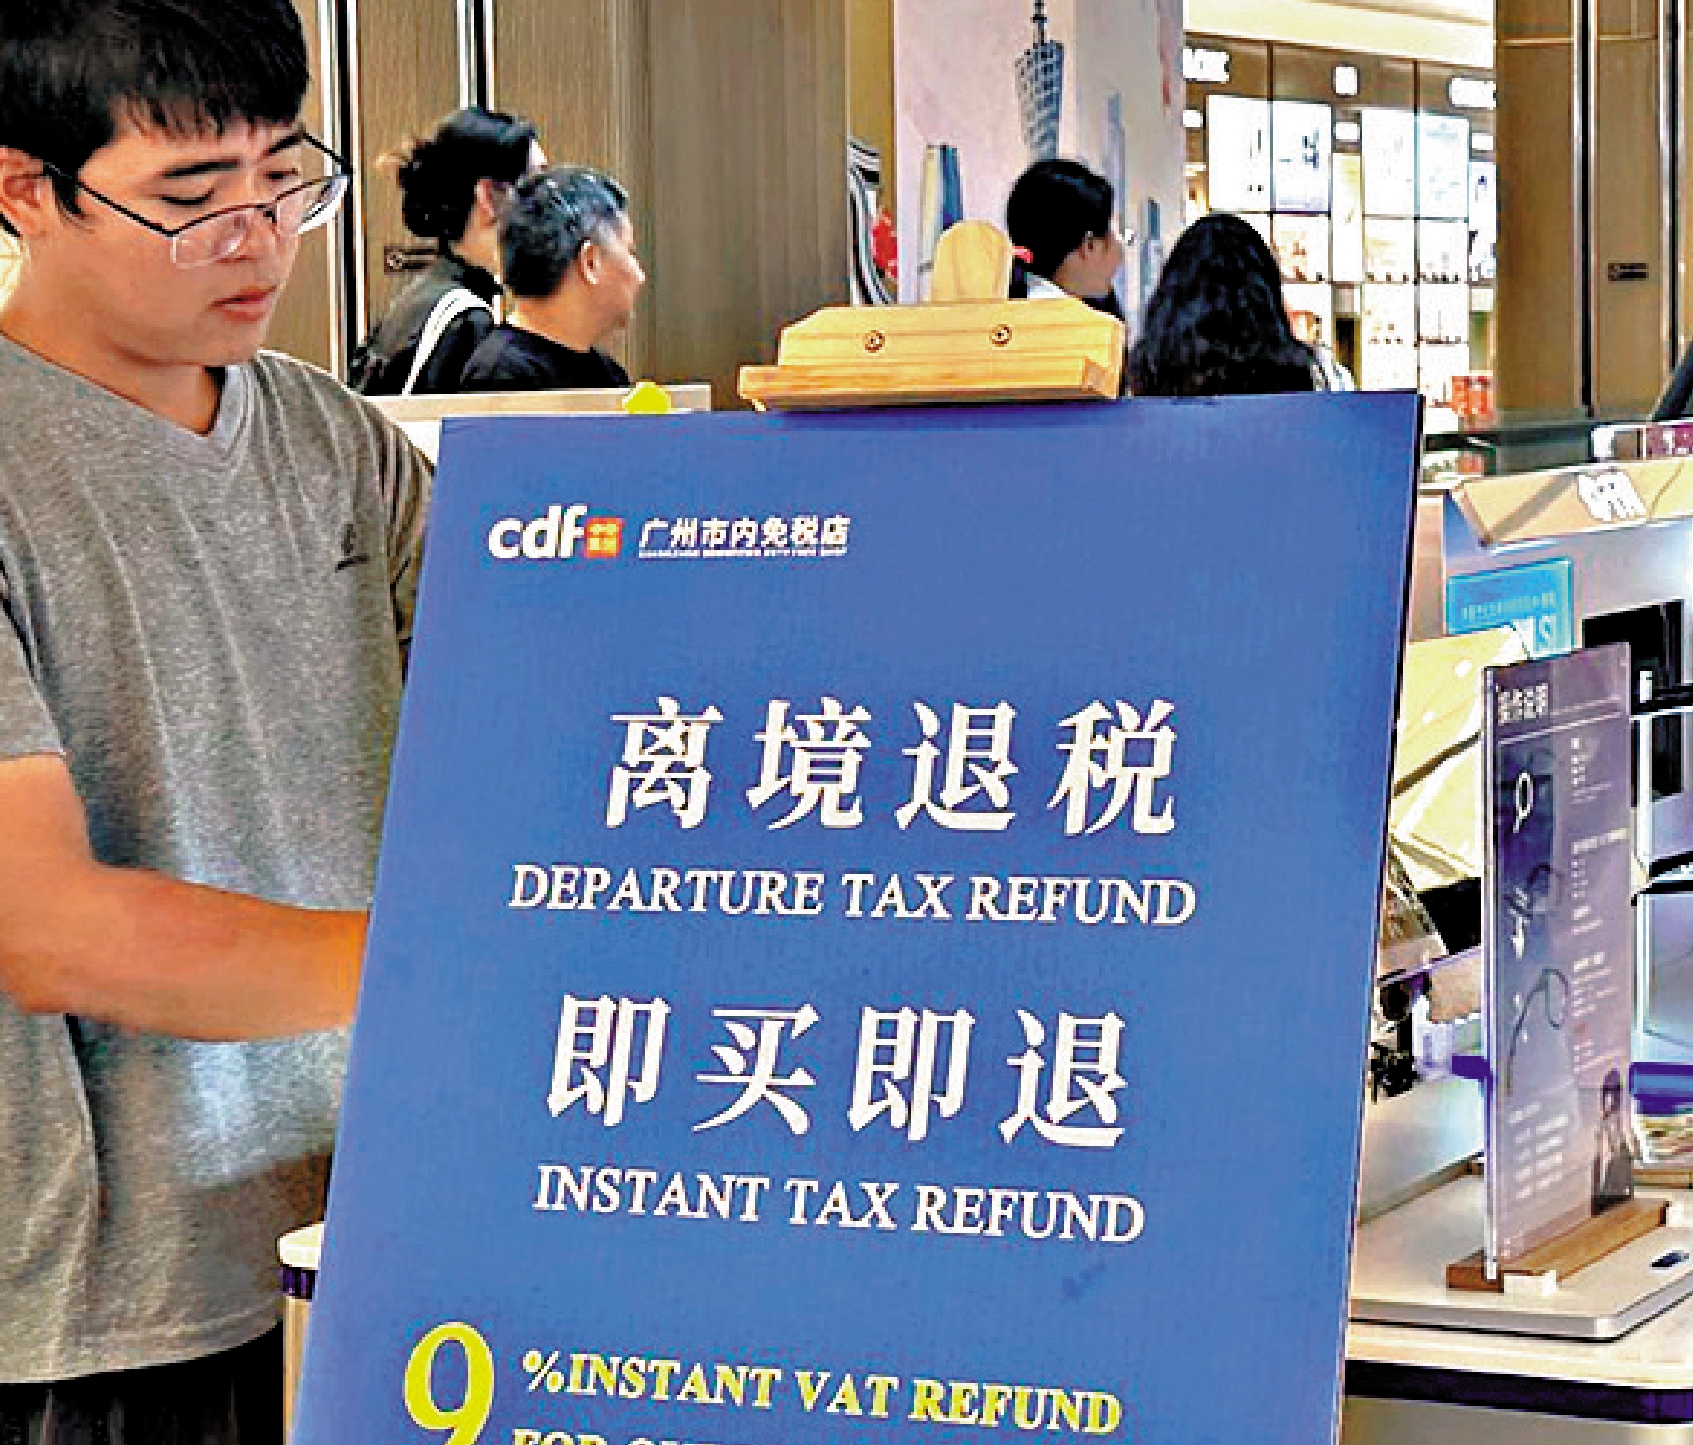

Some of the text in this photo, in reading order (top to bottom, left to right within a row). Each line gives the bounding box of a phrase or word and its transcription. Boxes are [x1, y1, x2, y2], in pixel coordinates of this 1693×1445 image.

[489, 505, 589, 559] cdf
[638, 514, 851, 549] 广州市内免税店
[606, 696, 1178, 834] 离境退税
[509, 865, 1196, 924] DEPARTURE TAX REFUND
[546, 994, 1126, 1147] 即买即退
[533, 1166, 1144, 1242] INSTANT TAX REFUND
[522, 1350, 1123, 1434] %INSTANT VAT REFUND
